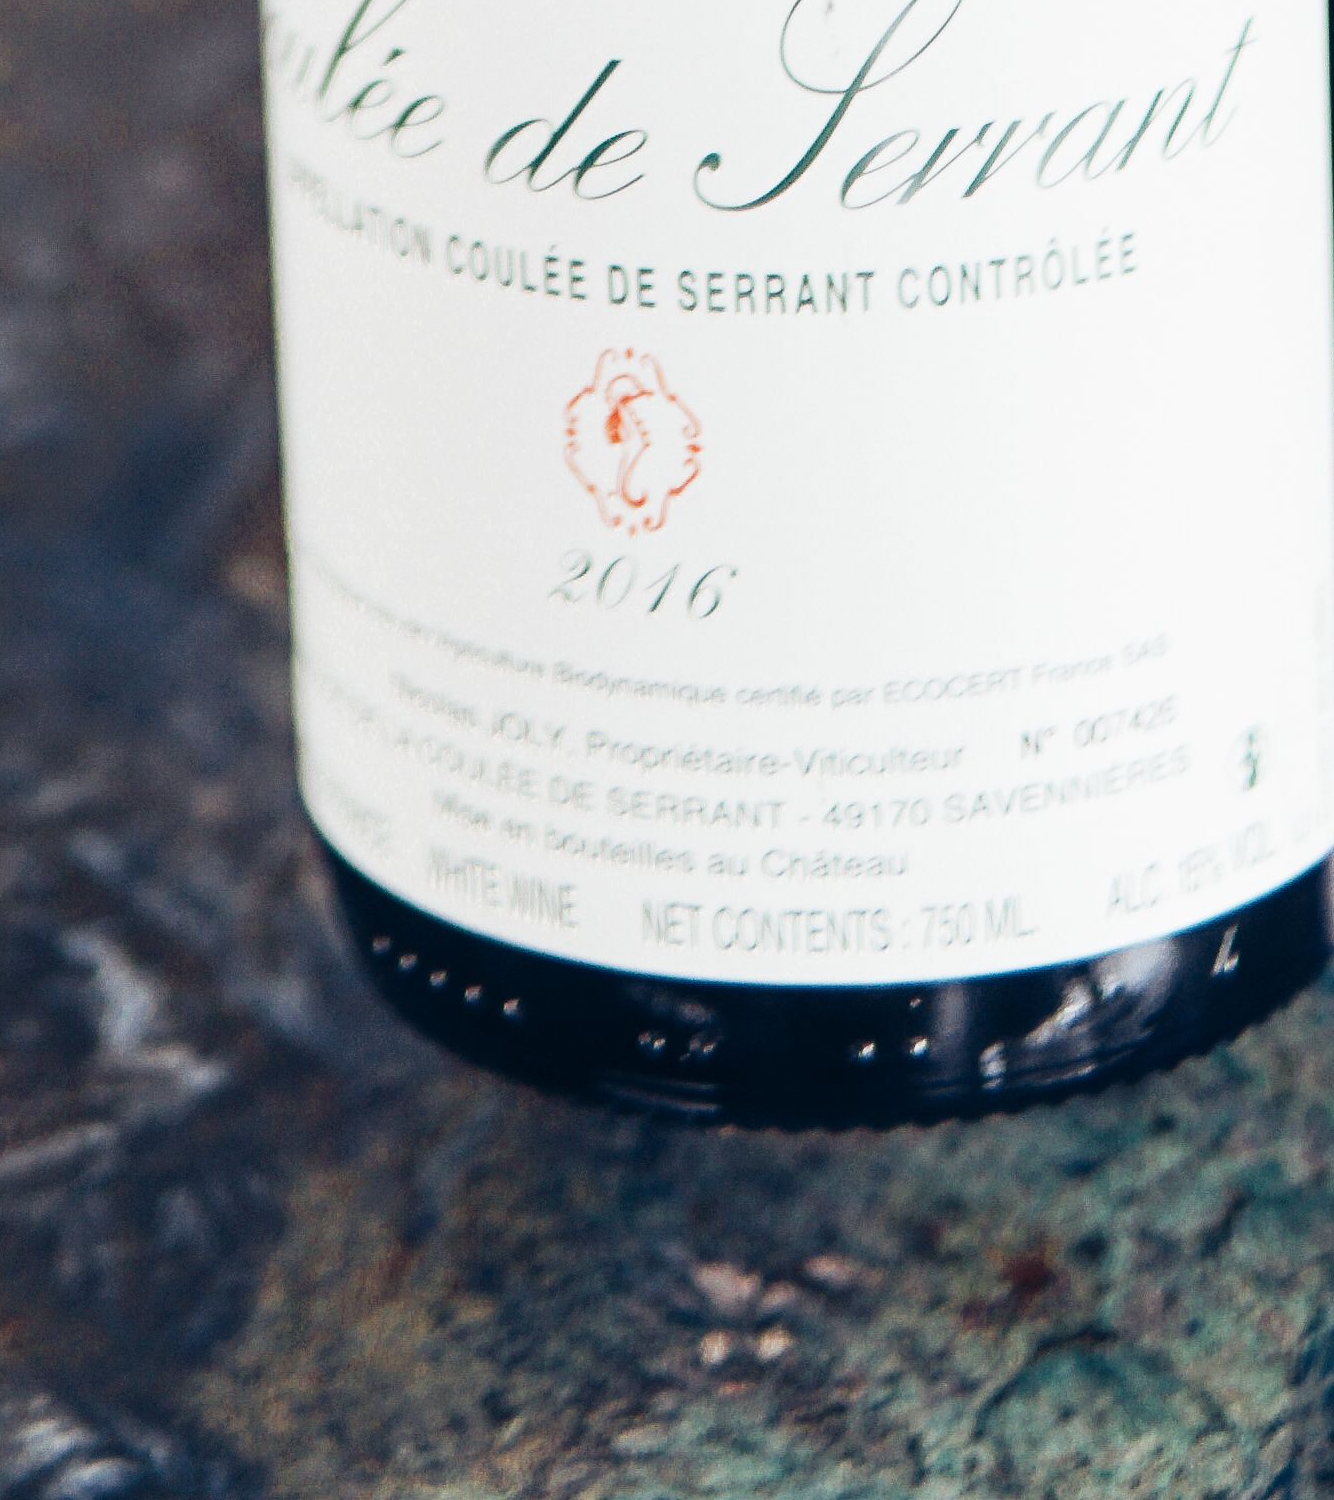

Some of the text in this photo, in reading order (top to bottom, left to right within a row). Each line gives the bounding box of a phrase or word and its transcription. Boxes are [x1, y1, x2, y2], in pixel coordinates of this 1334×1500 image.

[483, 58, 650, 200] de
[446, 230, 589, 301] COULÉE
[607, 266, 657, 310] DE
[679, 270, 878, 317] SERRANT
[897, 228, 1140, 310] CONTRÔLÉE
[547, 547, 741, 622] 2016
[881, 666, 1024, 705] ECOCERT
[547, 772, 597, 812] DE
[605, 785, 789, 832] SERRANT
[823, 794, 935, 832] 49170
[707, 845, 751, 878] au
[507, 872, 579, 930] WINE
[641, 896, 705, 950] NET
[711, 902, 894, 955] CONTENTS
[920, 900, 981, 950] 750
